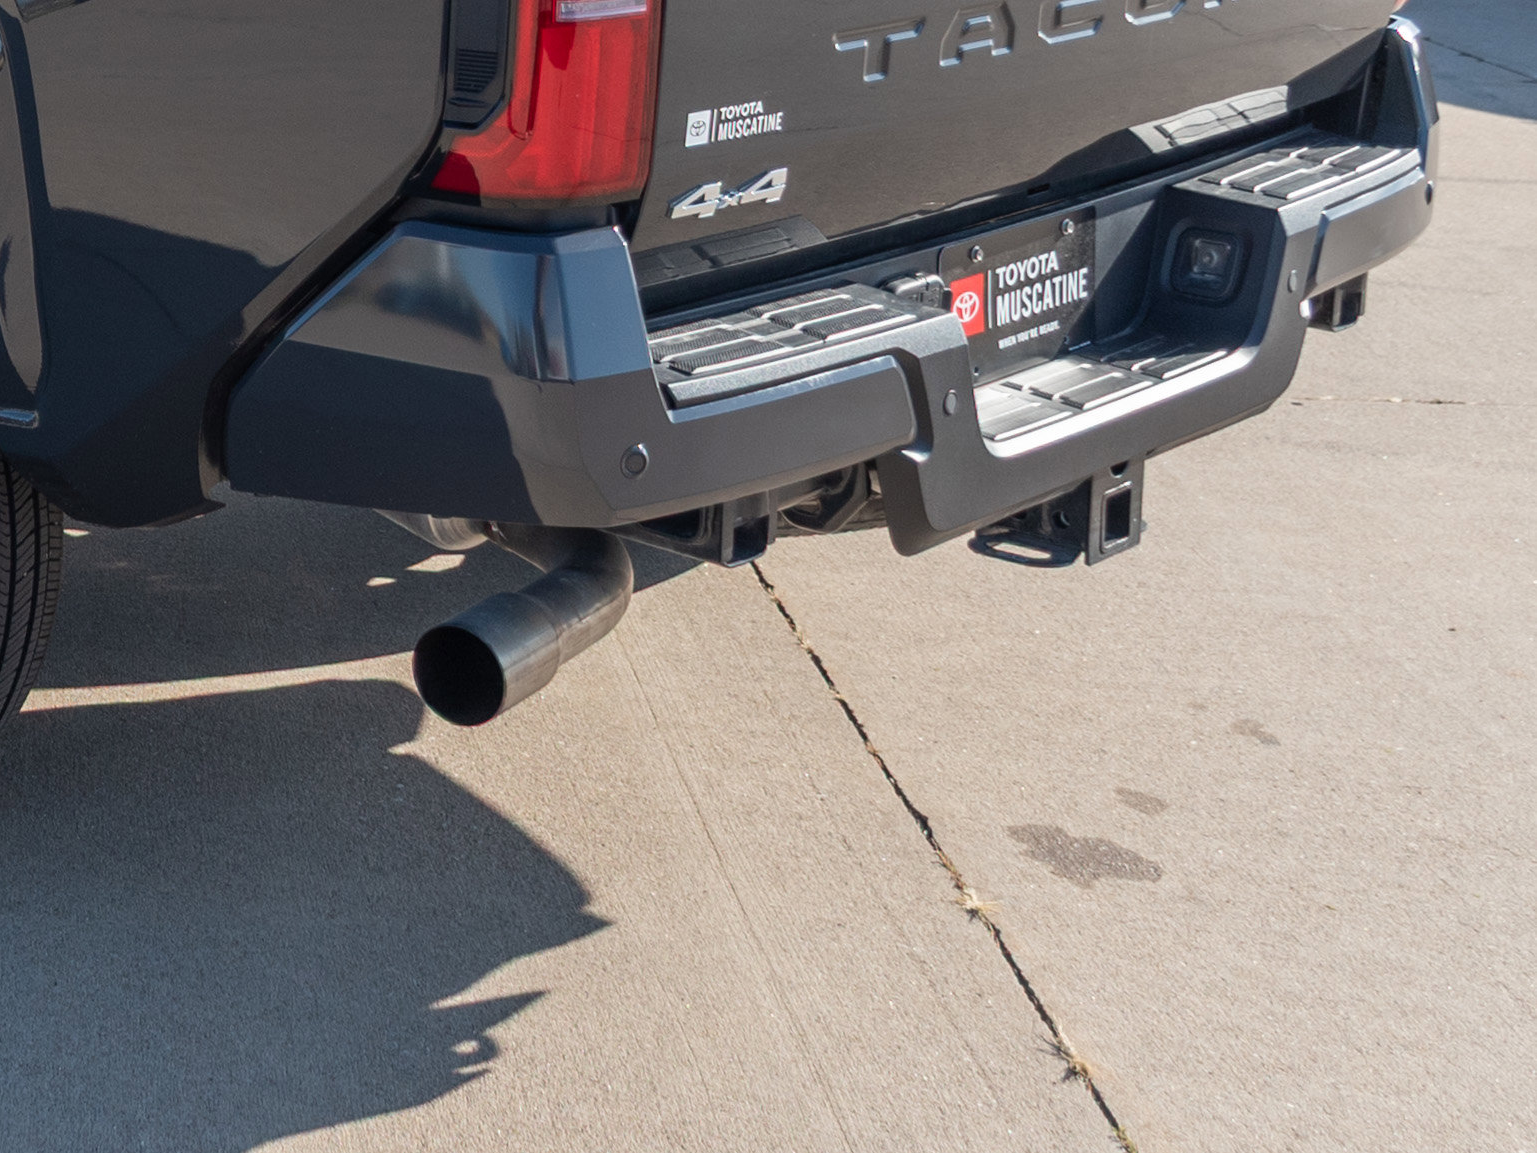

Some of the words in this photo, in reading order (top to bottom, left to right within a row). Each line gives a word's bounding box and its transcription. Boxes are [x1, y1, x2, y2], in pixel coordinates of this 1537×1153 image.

[717, 111, 784, 142] MUSCATINE
[719, 100, 764, 121] TOYOTA
[995, 250, 1059, 289] TOYOTA
[995, 267, 1089, 327] MUSCATINE
